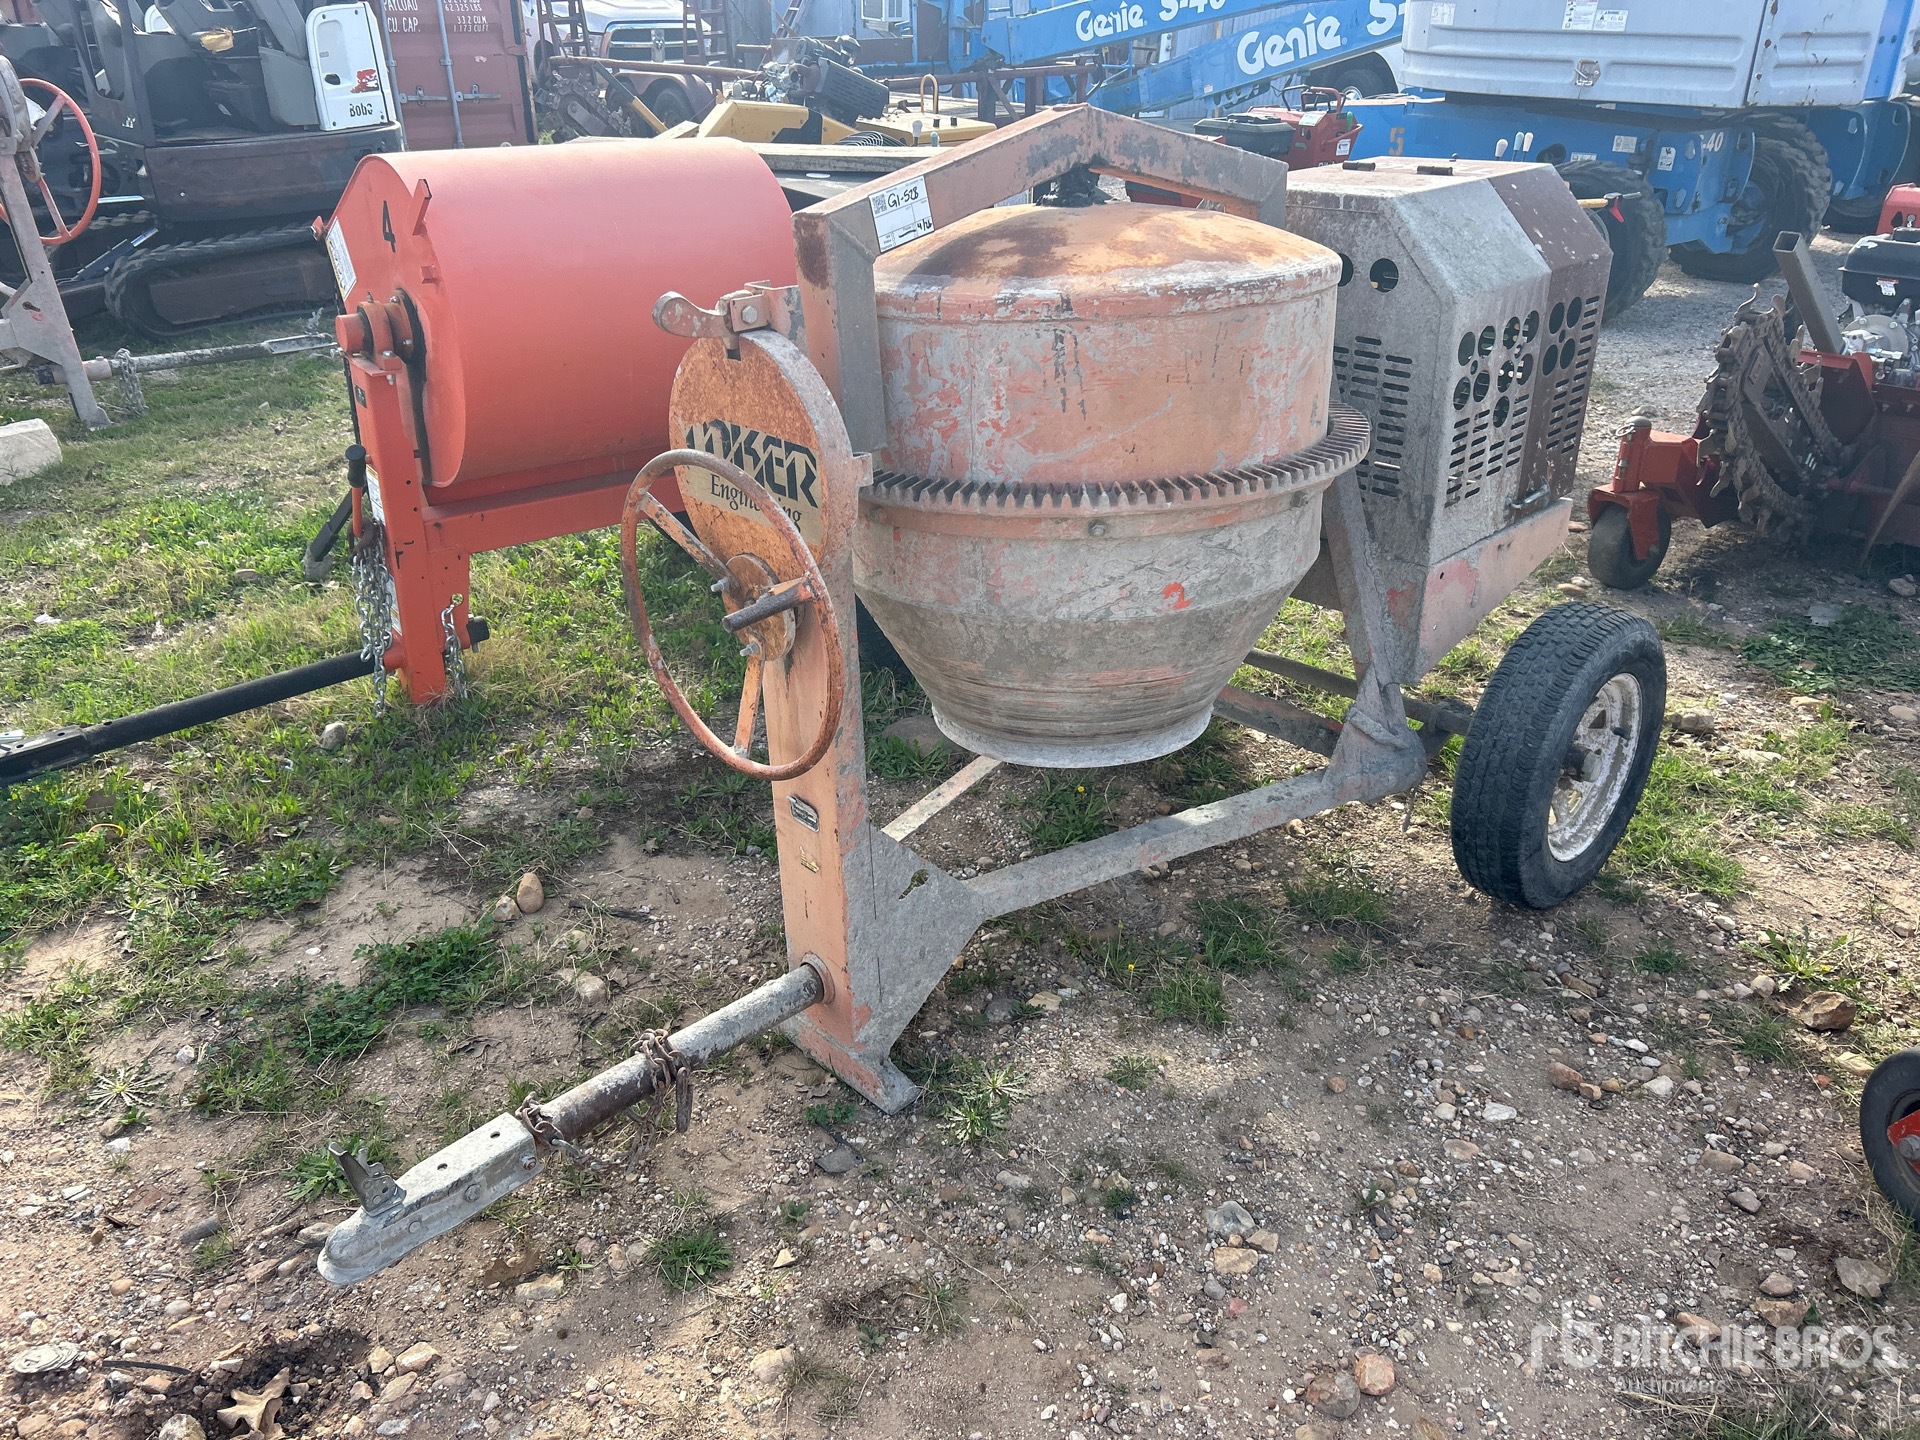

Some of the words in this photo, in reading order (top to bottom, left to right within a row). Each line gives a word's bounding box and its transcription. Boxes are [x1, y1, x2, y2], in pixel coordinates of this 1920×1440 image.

[402, 17, 421, 32] CAP.
[1076, 1, 1144, 42] Genie
[1237, 11, 1342, 75] Genie
[1389, 127, 1405, 156] 5
[382, 200, 396, 253] 4
